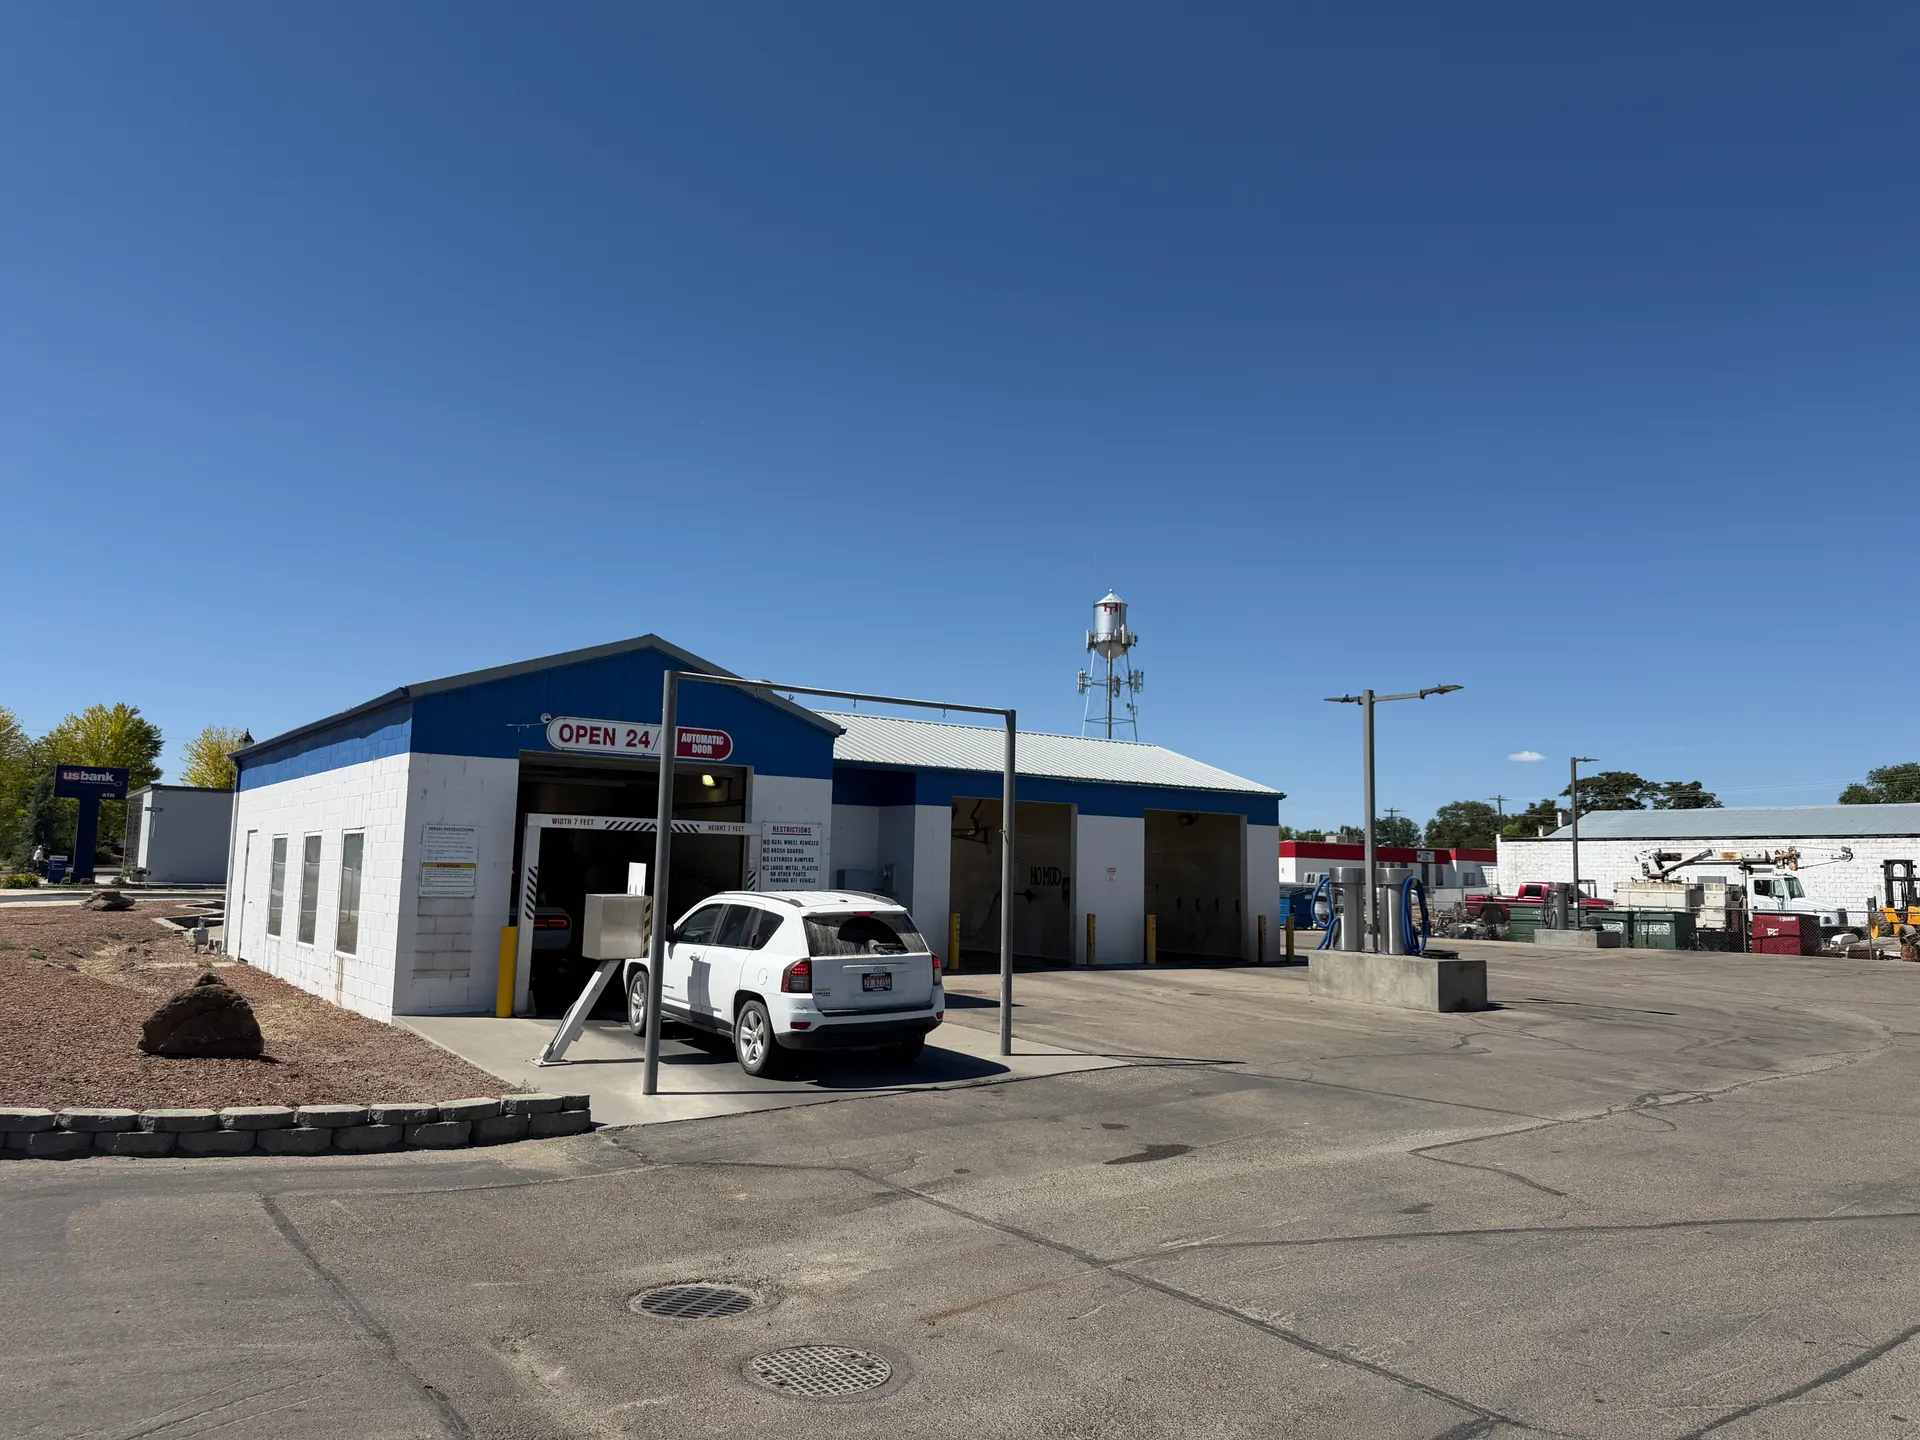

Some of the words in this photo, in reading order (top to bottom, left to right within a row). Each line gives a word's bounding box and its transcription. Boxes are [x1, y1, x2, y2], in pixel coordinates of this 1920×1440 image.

[558, 723, 617, 746] OPEN
[681, 733, 724, 745] AUTOMATIC
[691, 743, 713, 755] DOOR
[551, 817, 572, 826] WIDTH
[574, 818, 579, 826] 7
[580, 818, 595, 826] FEET
[707, 824, 726, 832] HEIGHT
[732, 825, 745, 833] FEET
[772, 825, 812, 834] RESTRICTIONS
[1030, 865, 1042, 886] NO
[1042, 865, 1062, 887] MUD
